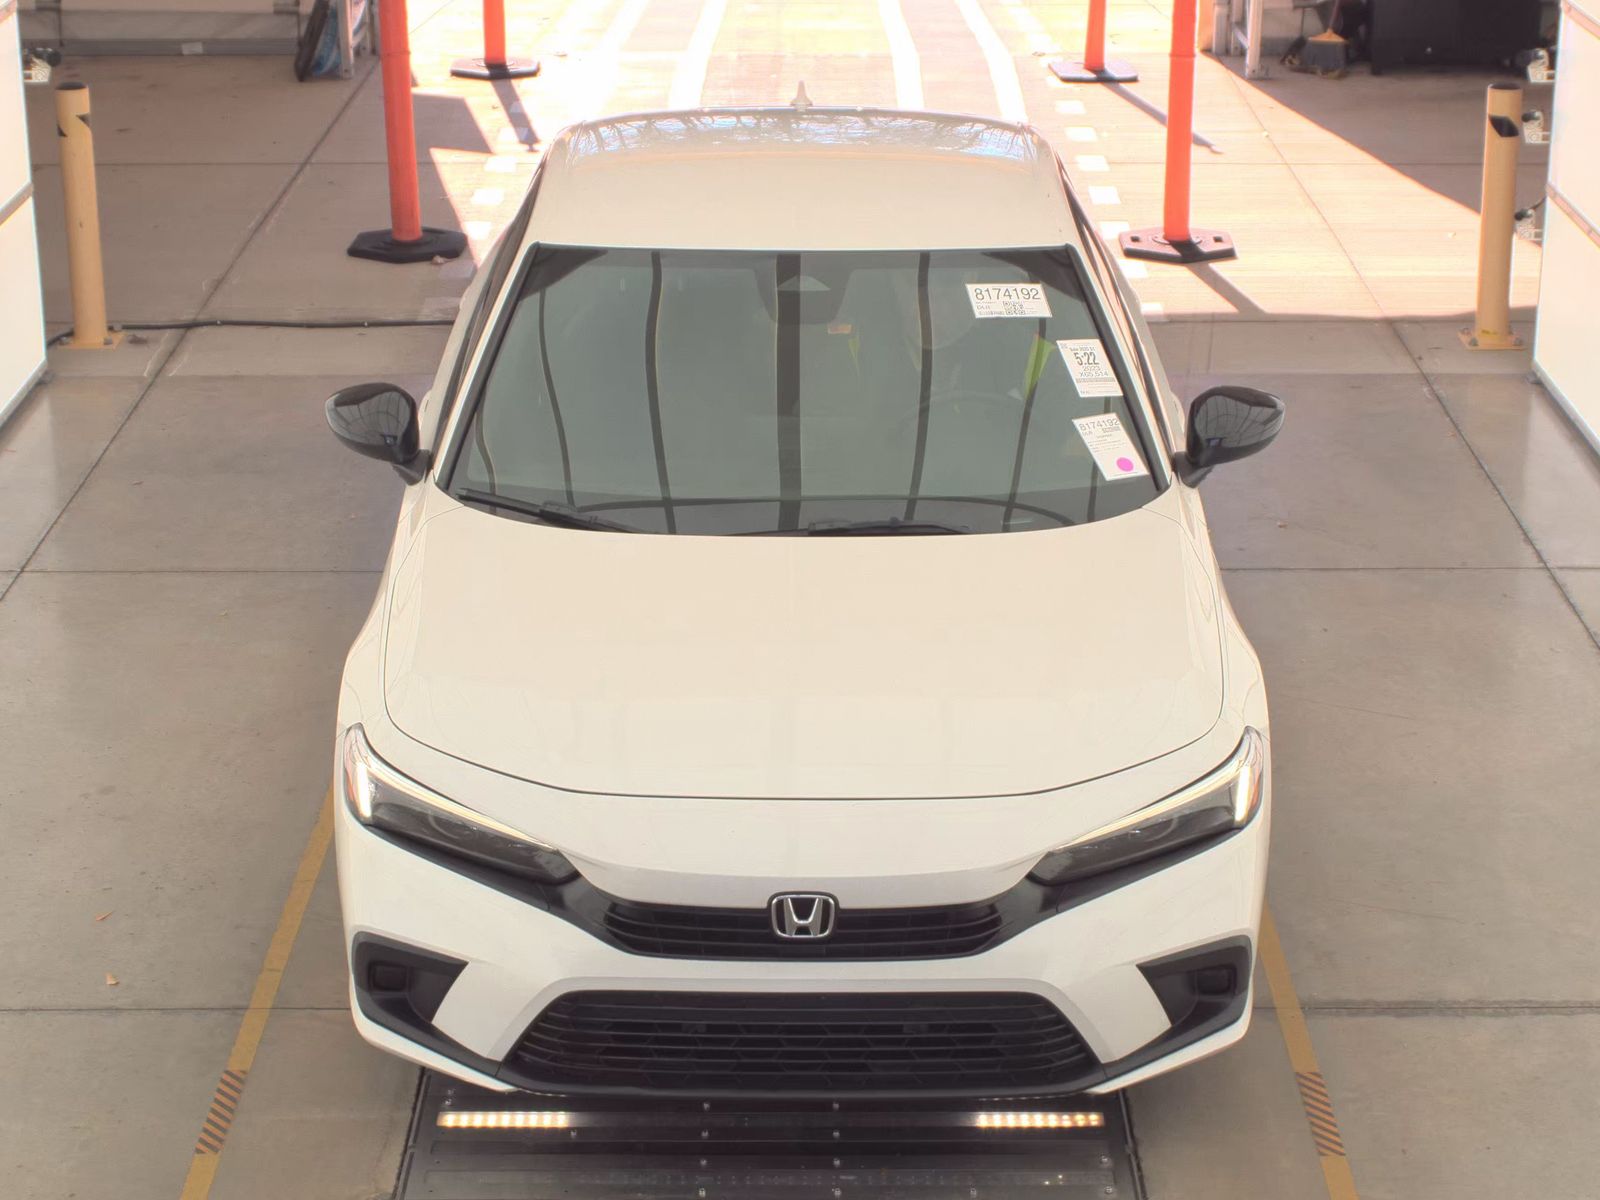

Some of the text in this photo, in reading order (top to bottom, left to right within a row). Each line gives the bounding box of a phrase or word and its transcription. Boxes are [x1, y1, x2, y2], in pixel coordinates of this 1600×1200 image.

[974, 287, 1041, 300] 8174192
[1073, 352, 1100, 365] 5:22
[1078, 418, 1120, 431] 8174192
